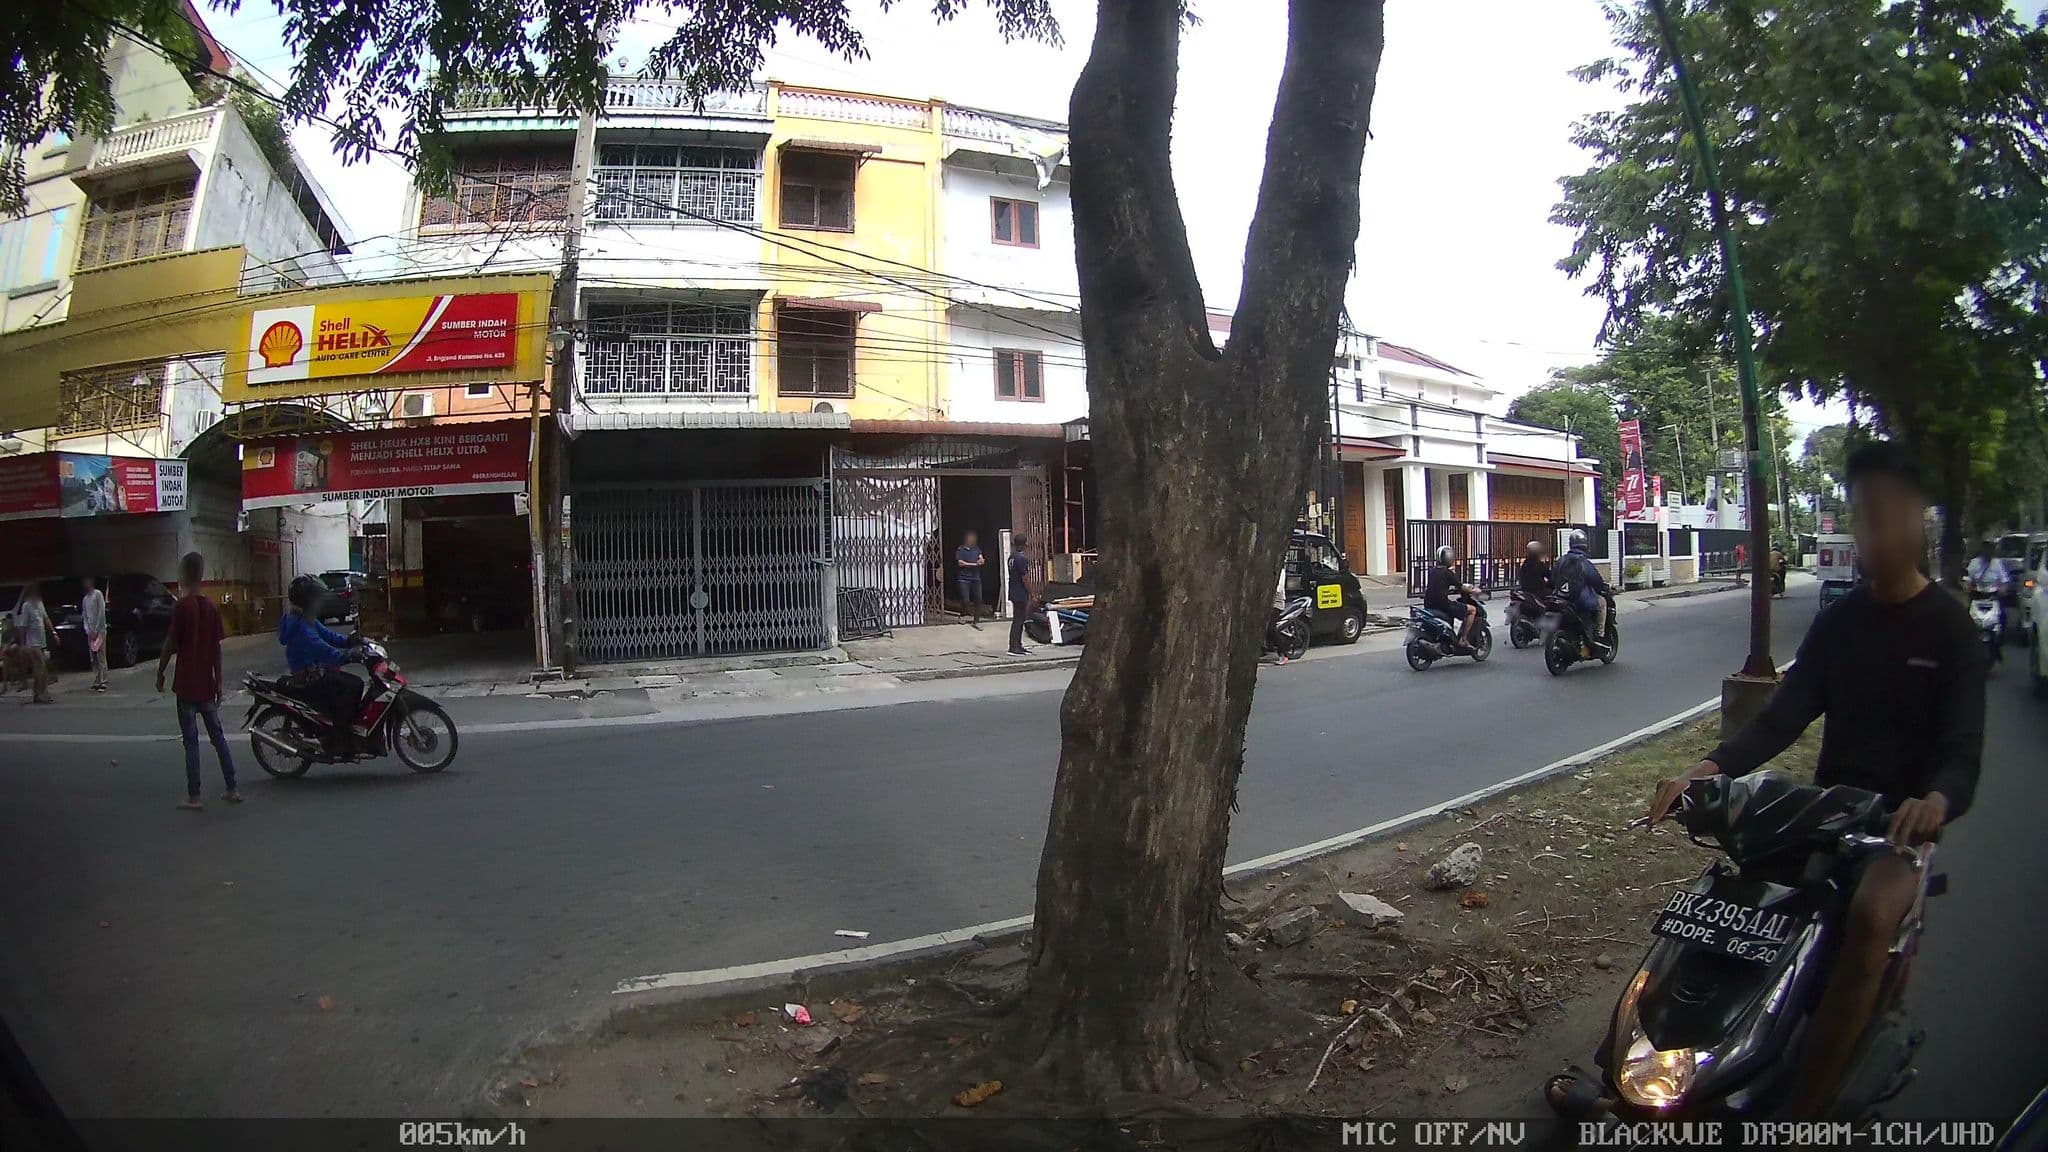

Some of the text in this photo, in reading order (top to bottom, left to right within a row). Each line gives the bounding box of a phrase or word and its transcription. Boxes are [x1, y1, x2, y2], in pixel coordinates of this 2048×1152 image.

[319, 317, 350, 332] Shell
[441, 318, 507, 330] SUMBER INDAH
[317, 323, 392, 351] HELIX
[473, 329, 507, 339] MOTOR
[315, 354, 336, 362] AUTO
[360, 349, 391, 358] CENTRE
[350, 433, 509, 451] SHELL HELIX HX8 KINI BERGANTI
[350, 445, 488, 462] MENJADI SHELL HELIX ULTRA
[158, 464, 184, 477] SUMBER
[161, 480, 182, 492] INDAH
[1625, 474, 1640, 492] 77
[160, 494, 184, 507] MOTOR
[321, 486, 435, 502] SUMBER INDAH MOTOR
[1660, 917, 1716, 945] #DOPE.
